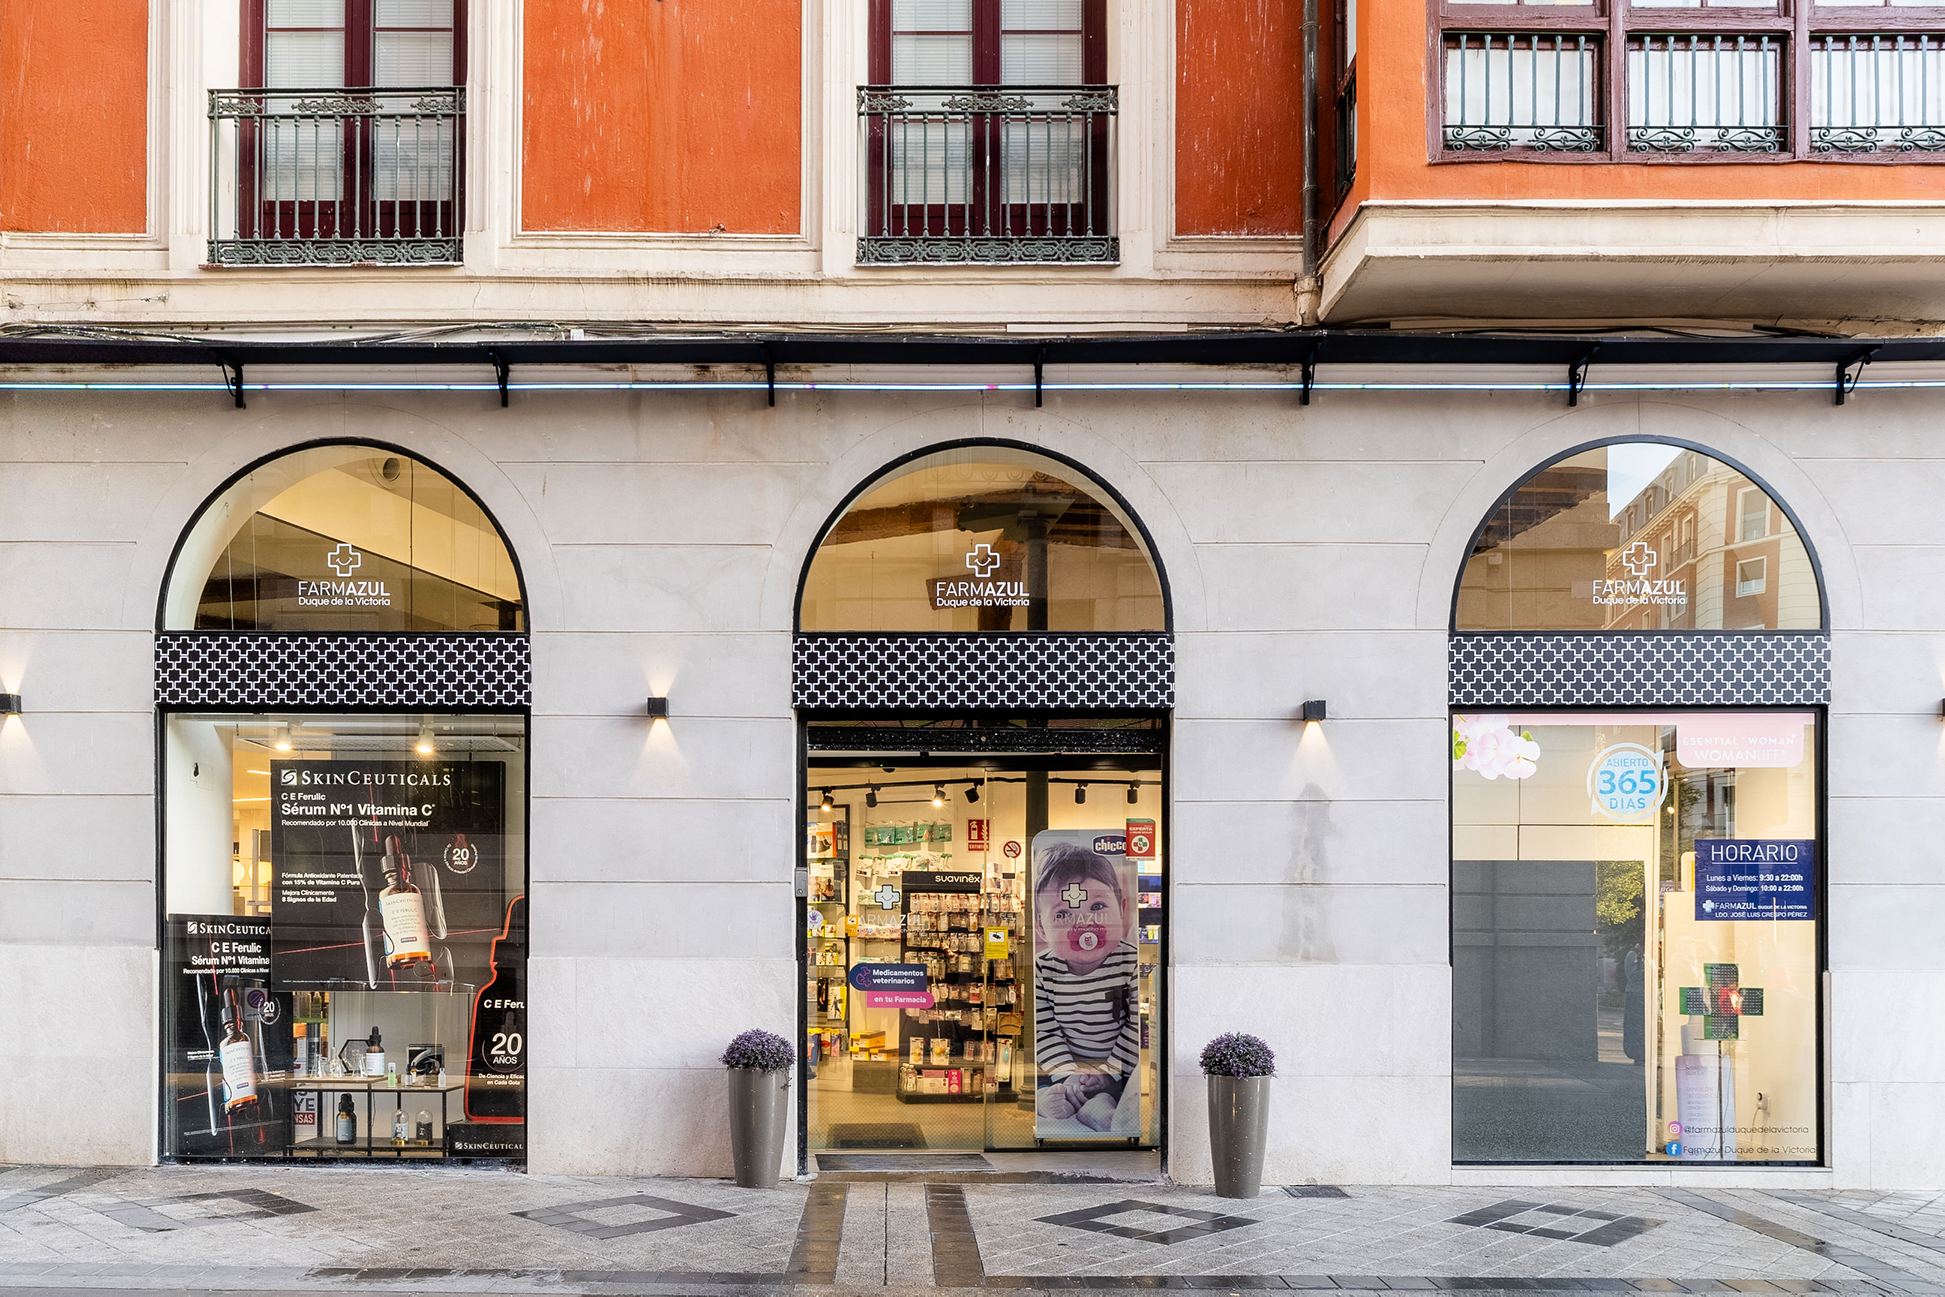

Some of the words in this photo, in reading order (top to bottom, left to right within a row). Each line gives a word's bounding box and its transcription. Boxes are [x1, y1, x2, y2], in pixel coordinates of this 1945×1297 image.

[298, 580, 391, 596] FARMAZUL
[936, 581, 1030, 597] FARMAZUL
[1592, 579, 1686, 595] FARMAZUL
[298, 597, 330, 607] Duque
[330, 597, 343, 606] de
[344, 597, 354, 606] la
[354, 597, 391, 606] Victoria
[936, 598, 968, 608] Duque
[969, 598, 982, 606] de
[983, 598, 993, 606] la
[993, 598, 1030, 606] Victoria
[1592, 596, 1624, 606] Duque
[1625, 596, 1638, 605] de
[1639, 596, 1649, 605] la
[1649, 596, 1687, 605] Victoria
[1748, 736, 1795, 745] WOMAN
[1606, 758, 1649, 767] ABIERTO
[301, 770, 451, 786] SKINCEUTICALS
[1598, 769, 1656, 795] 365
[281, 792, 288, 801] C
[290, 792, 297, 801] E
[298, 792, 326, 801] Ferulic
[281, 803, 326, 816] Sérum
[357, 803, 418, 816] Vitamina
[281, 819, 325, 827] Recomendado
[388, 819, 404, 827] Nivel
[452, 847, 470, 861] 20
[1711, 844, 1798, 861] HORARIO
[1706, 874, 1726, 882] Lunes
[1732, 874, 1759, 882] Viernes:
[1759, 874, 1774, 882] 9:30
[1780, 874, 1803, 882] 22:00h
[1705, 884, 1727, 892] Sábado
[1727, 886, 1732, 894] y
[1732, 884, 1760, 894] Domingo:
[1760, 884, 1777, 892] 10:00
[1782, 884, 1804, 892] 22:00h
[1714, 902, 1757, 910] FARMAZUL
[1730, 910, 1746, 918] JOSÉ
[1787, 910, 1808, 918] PÉREZ
[211, 942, 220, 953] C
[222, 942, 230, 953] E
[232, 942, 262, 953] Ferulic
[191, 955, 219, 966] Sérum
[238, 955, 270, 965] Vitamina
[872, 968, 924, 977] Medicamentos
[872, 977, 915, 985] veterinarios
[263, 1001, 275, 1013] 20
[483, 999, 492, 1009] C
[494, 999, 502, 1009] E
[490, 1032, 523, 1055] 20
[492, 1055, 518, 1065] AÑOS
[1724, 1145, 1754, 1156] Duque
[1756, 1145, 1769, 1154] de
[1771, 1145, 1780, 1154] la
[1781, 1145, 1816, 1154] Victoria
